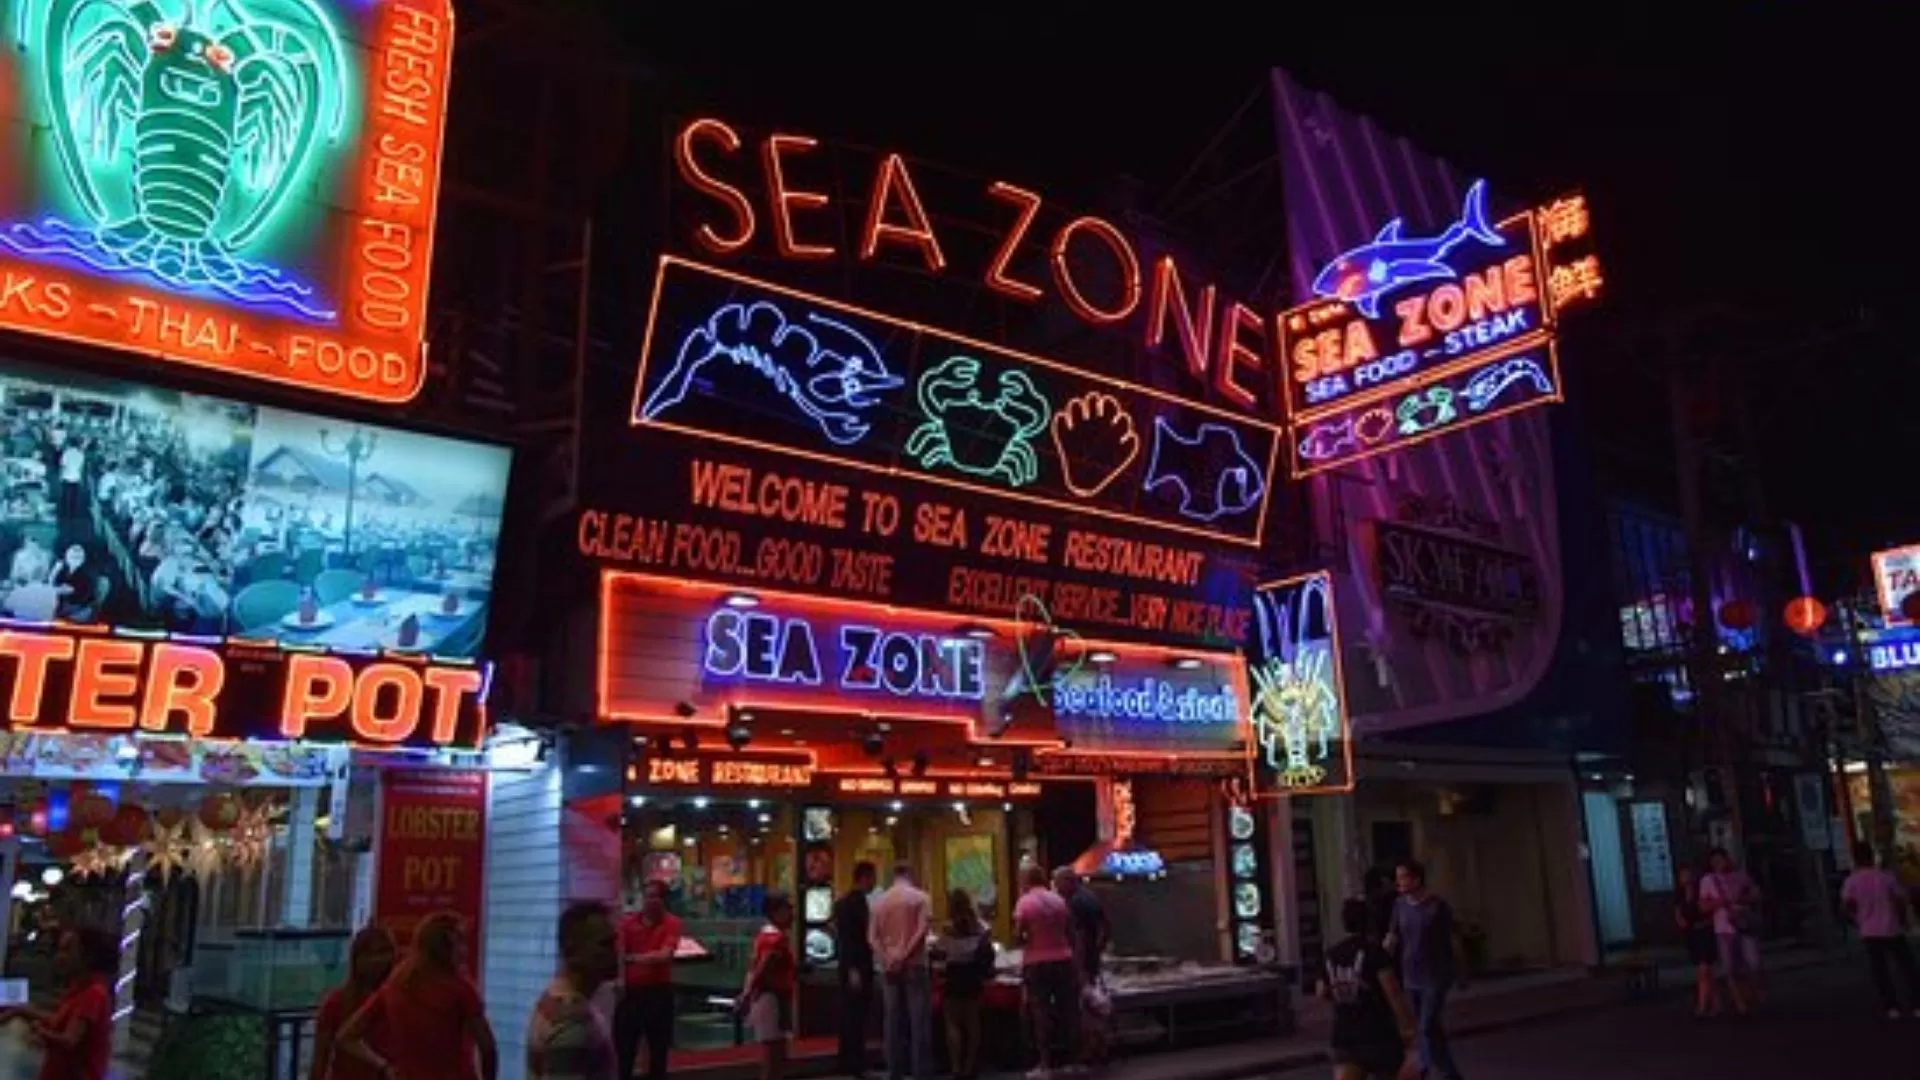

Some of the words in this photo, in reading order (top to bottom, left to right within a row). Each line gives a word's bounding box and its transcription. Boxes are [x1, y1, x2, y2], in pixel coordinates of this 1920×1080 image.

[385, 3, 440, 125] FRESH
[374, 133, 427, 206] SEA
[360, 217, 413, 328] FOOD
[676, 117, 945, 274] SEA
[986, 180, 1265, 405] ZONE
[0, 272, 71, 319] KS
[128, 296, 239, 354] THAI
[287, 334, 407, 386] FOOD
[1293, 319, 1378, 382] SEA
[1395, 254, 1537, 346] ZONE
[1304, 375, 1349, 402] SEA
[1353, 349, 1418, 386] FOOD
[1443, 308, 1528, 355] STEAK
[578, 509, 668, 565] CLEAN
[830, 547, 895, 594] TASTE
[690, 460, 849, 529] WELCOME
[861, 490, 900, 537] TO
[912, 502, 968, 549] SEA
[980, 515, 1051, 563] ZONE
[1063, 530, 1205, 585] RESTAURANT
[0, 629, 225, 737] TER
[281, 654, 482, 743] POT
[704, 608, 822, 685] SEA
[840, 624, 986, 699] ZONE
[387, 805, 480, 841] LOBSTER
[404, 855, 461, 890] POT
